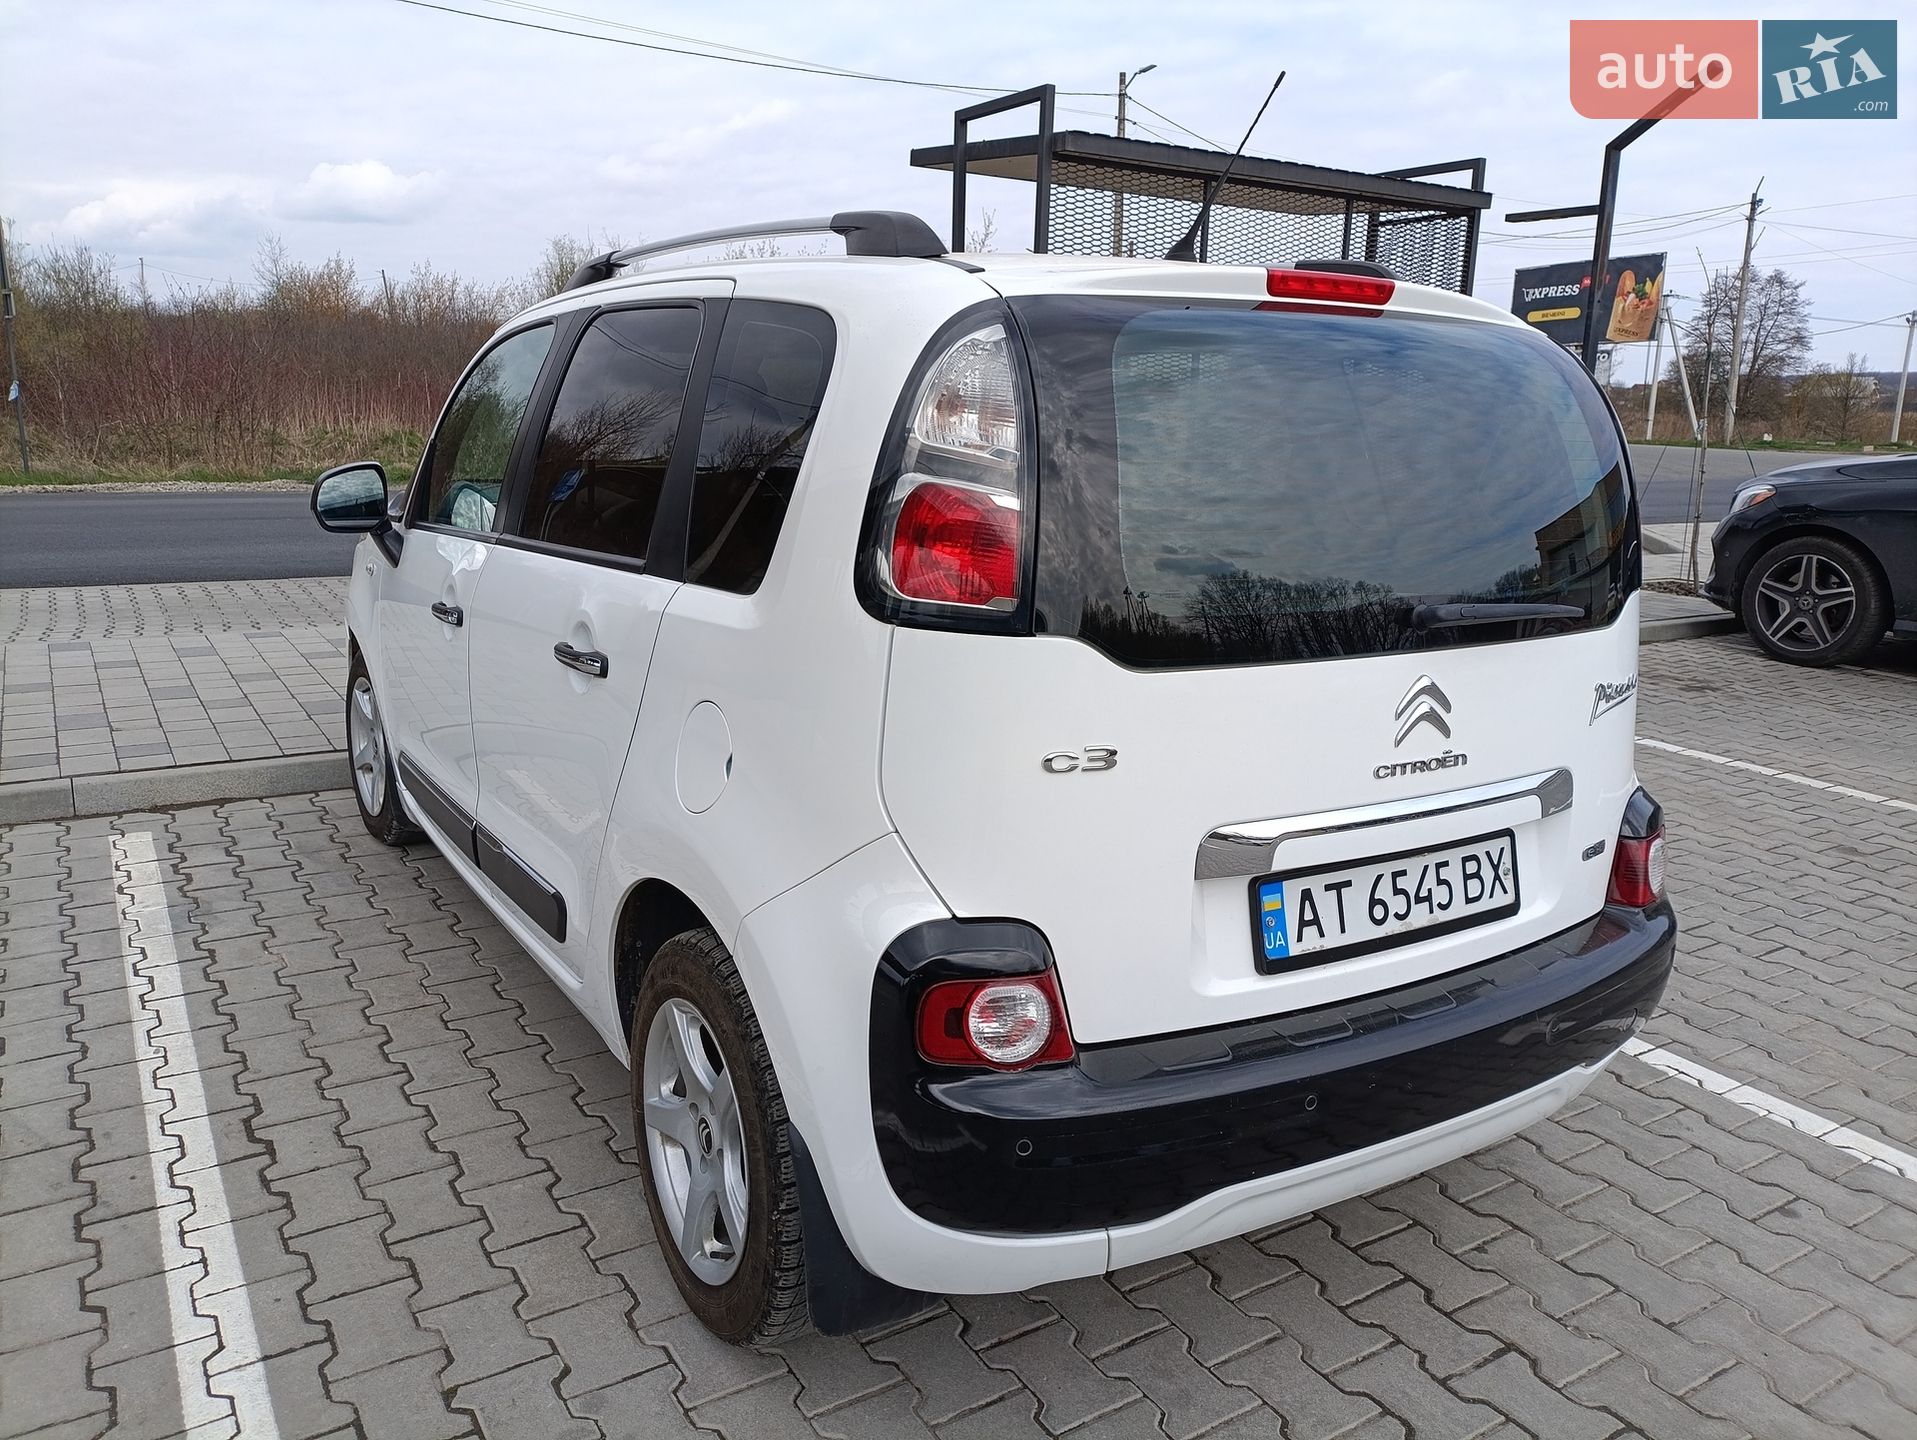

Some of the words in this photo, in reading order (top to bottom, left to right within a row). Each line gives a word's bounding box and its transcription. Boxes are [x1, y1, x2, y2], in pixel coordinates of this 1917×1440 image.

[1041, 744, 1118, 774] C3
[1296, 879, 1353, 943] AT
[1368, 859, 1453, 927] 6545
[1461, 846, 1509, 905] BX
[1265, 932, 1285, 949] UA
